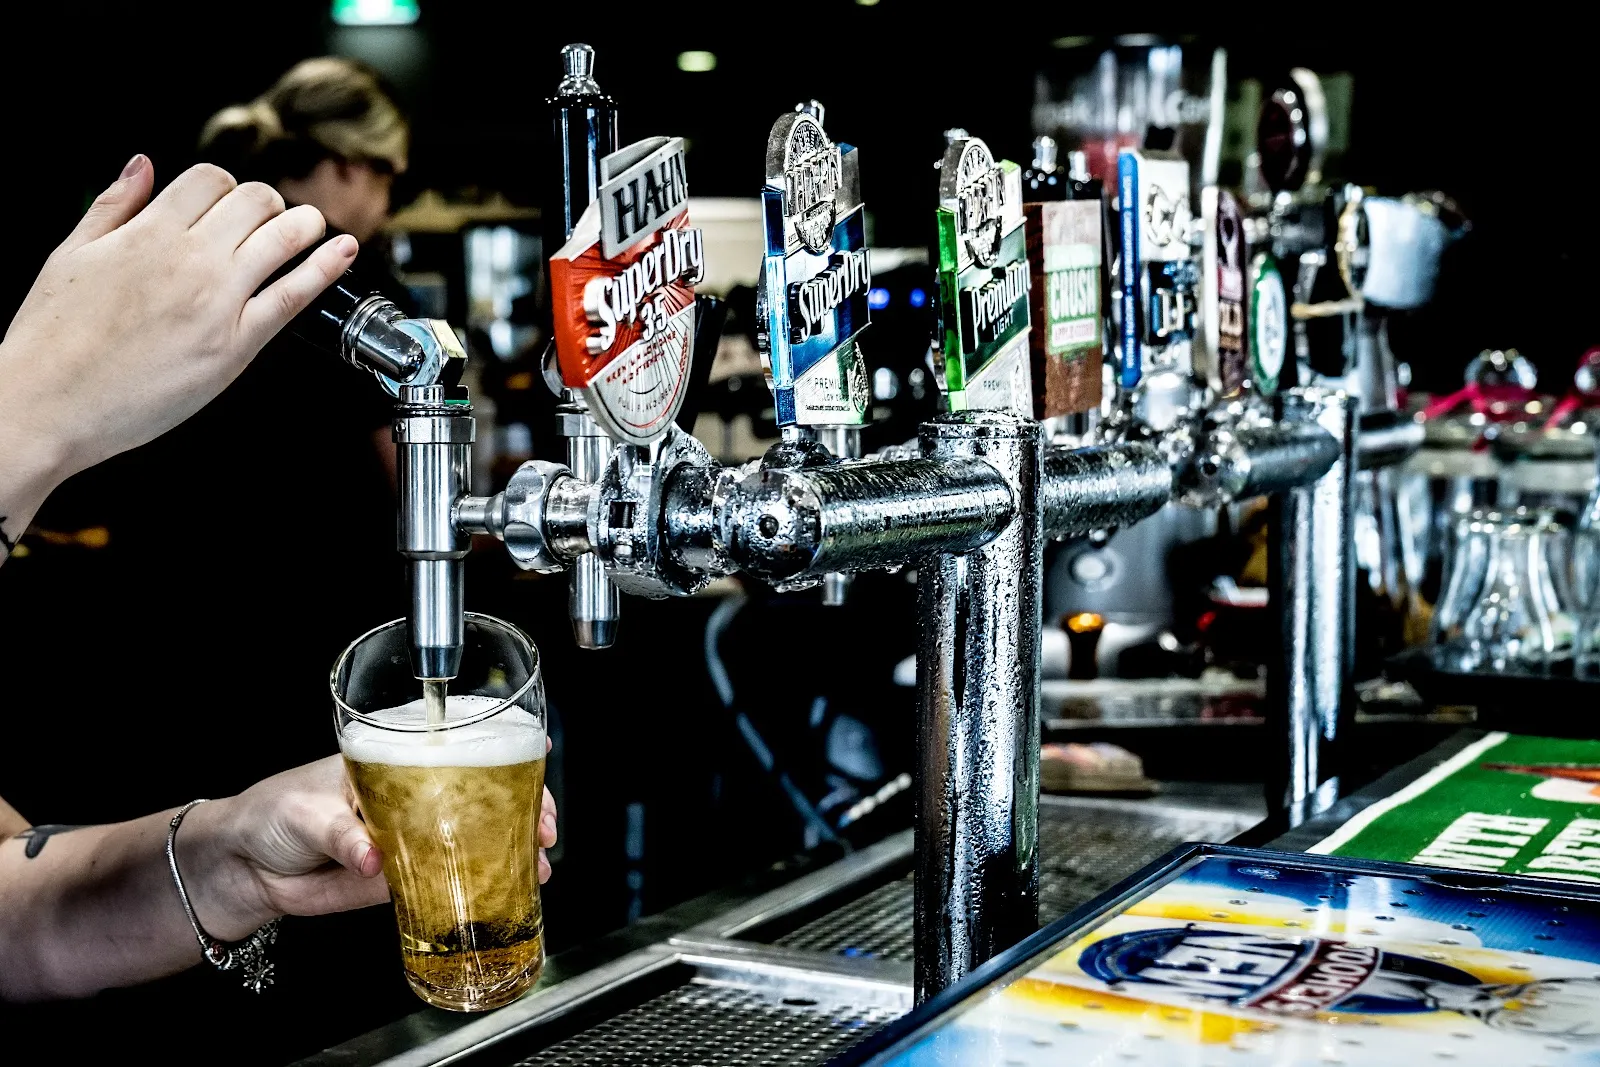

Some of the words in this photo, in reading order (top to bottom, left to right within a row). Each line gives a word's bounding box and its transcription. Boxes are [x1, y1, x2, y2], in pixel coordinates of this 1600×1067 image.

[612, 149, 687, 245] HAHN
[1050, 267, 1097, 320] CRUSH
[992, 307, 1014, 341] LIGHT
